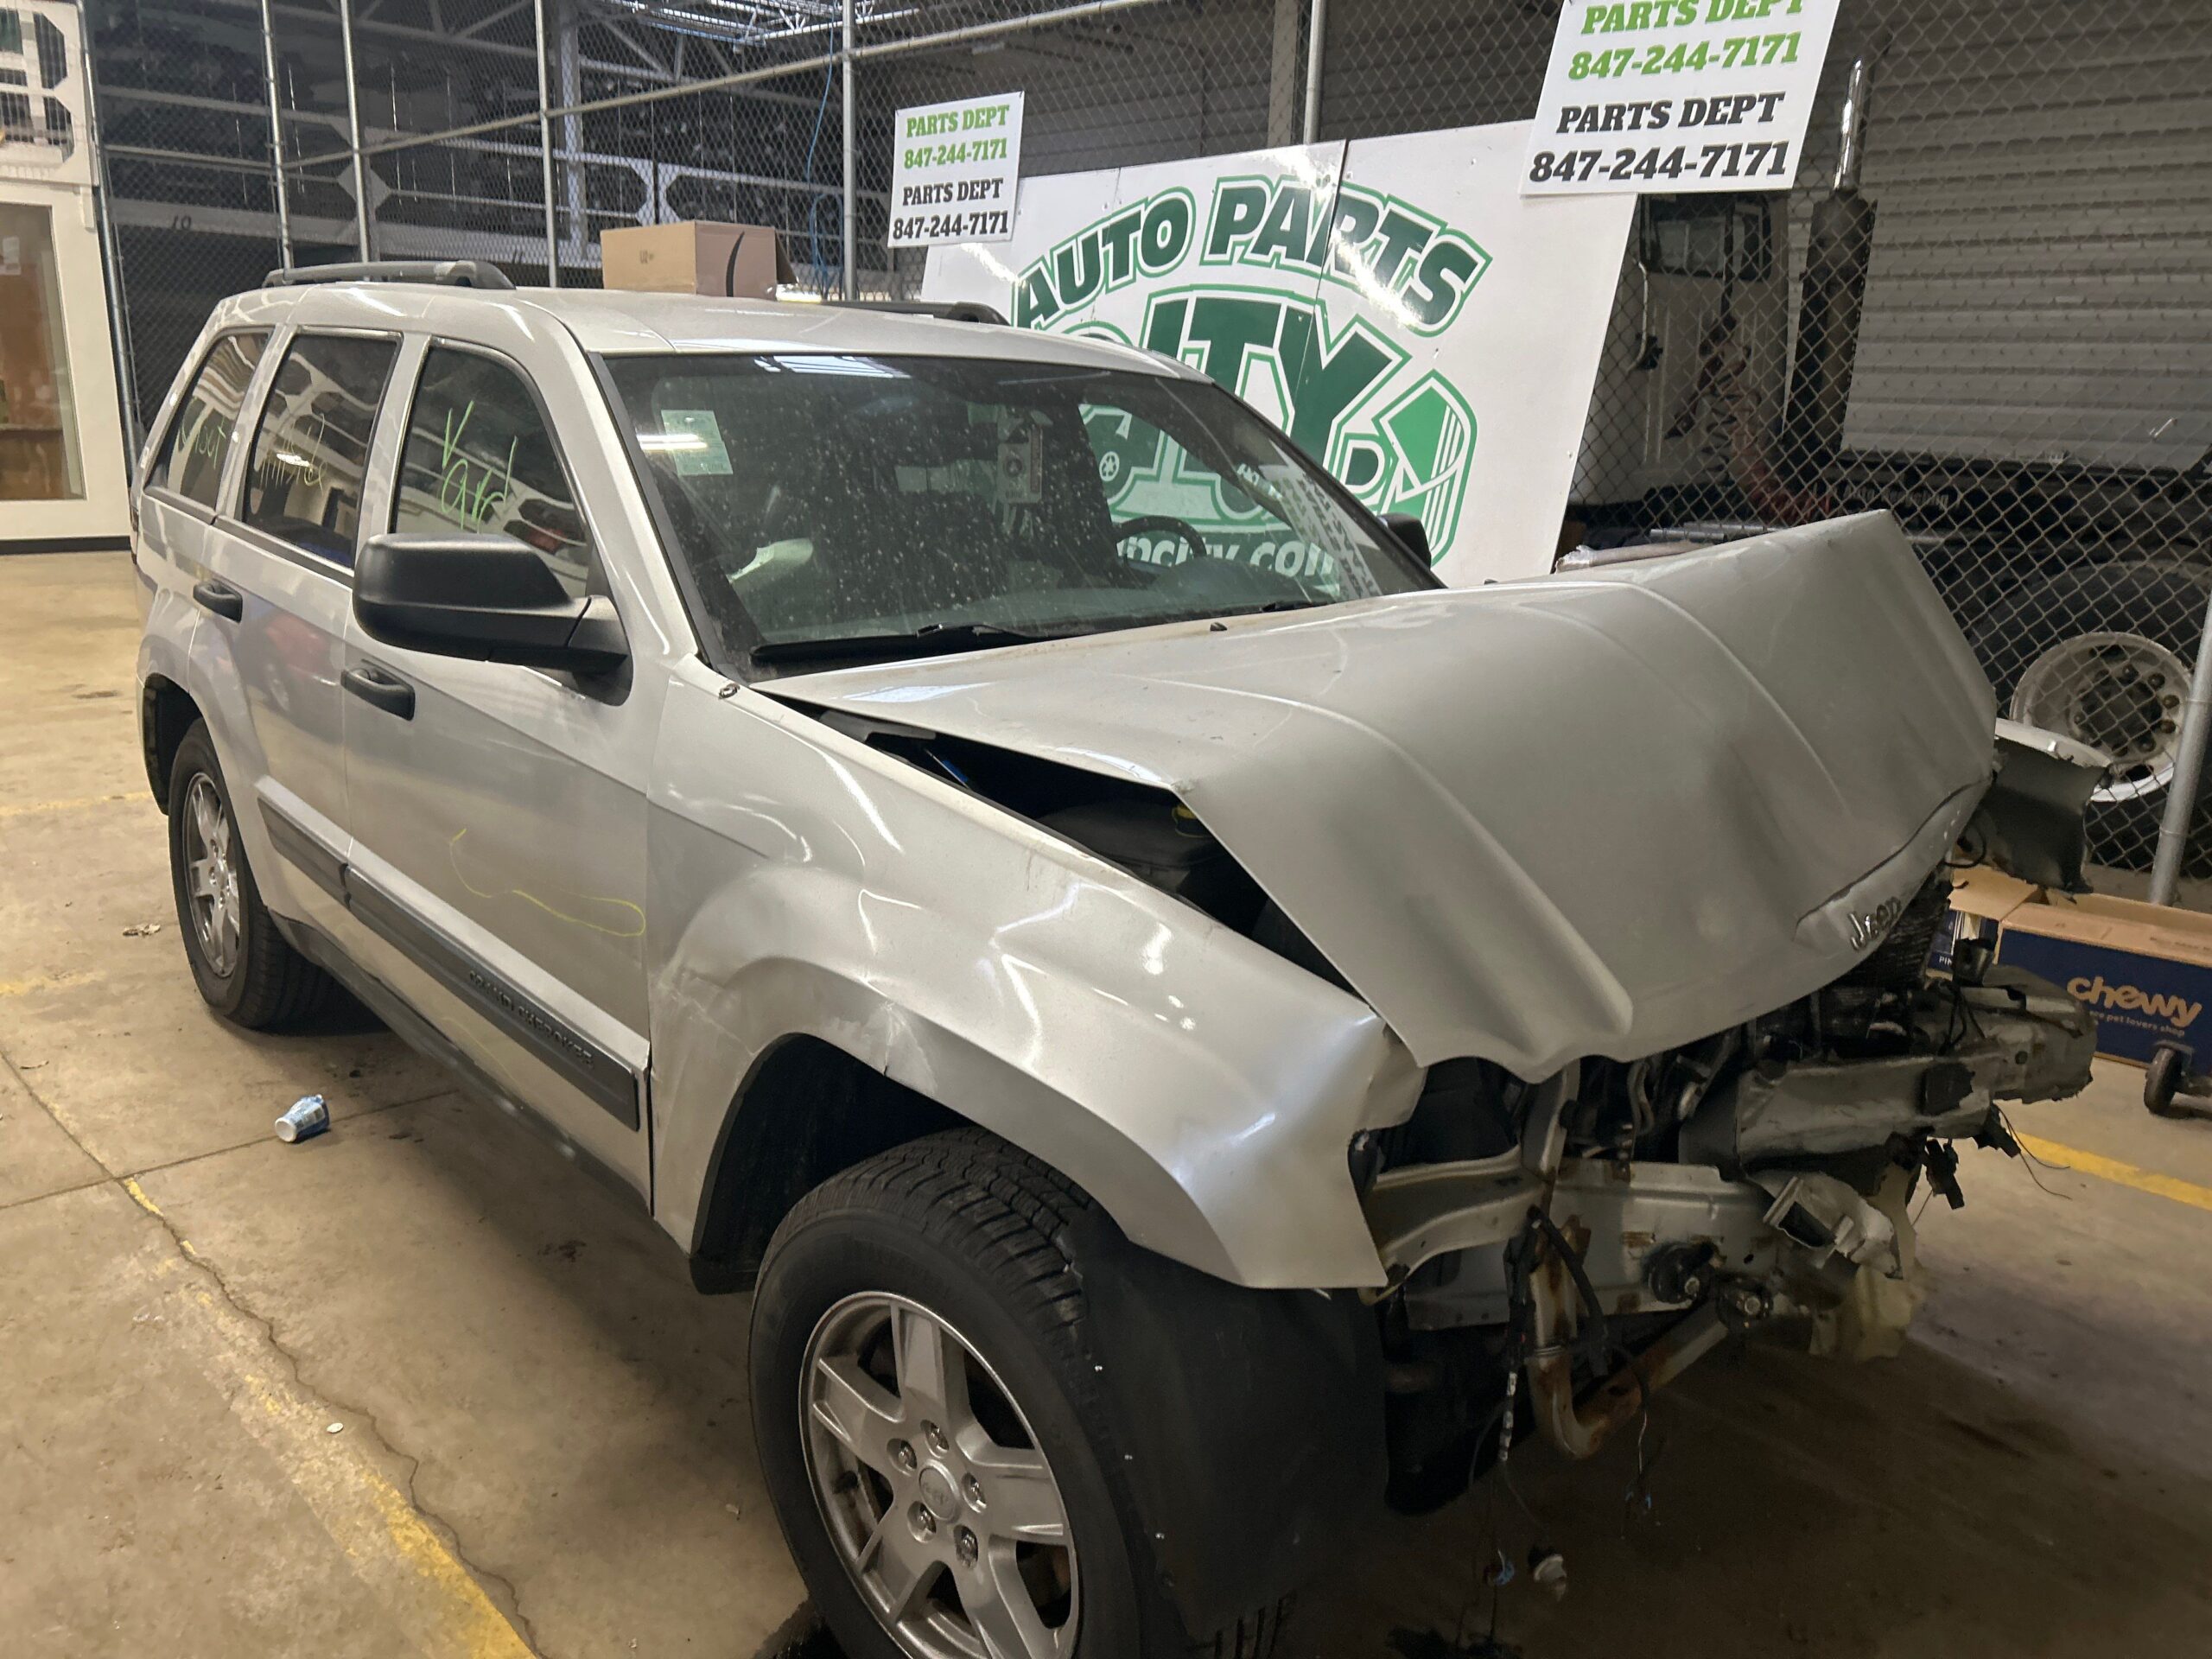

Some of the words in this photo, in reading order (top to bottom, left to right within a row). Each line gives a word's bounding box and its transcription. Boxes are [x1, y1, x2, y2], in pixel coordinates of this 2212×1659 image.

[1580, 0, 1700, 35] PARTS
[1567, 30, 1802, 80] 847-244-7171
[906, 111, 959, 138] PARTS
[962, 105, 1010, 130] DEPT
[1556, 99, 1673, 134] PARTS
[1678, 92, 1786, 128] DEPT
[904, 138, 1007, 169] 847-244-7171
[1529, 139, 1790, 182] 847-244-7171
[902, 182, 954, 207] PARTS
[957, 177, 1004, 201] DEPT
[893, 210, 1009, 240] 847-244-7171
[1014, 191, 1192, 328] AUTO
[1205, 176, 1484, 331] PARTS
[1076, 294, 1395, 471] ITY
[2066, 976, 2202, 1028] chewy
[2107, 1014, 2124, 1023] pet
[2126, 1016, 2158, 1031] lovers
